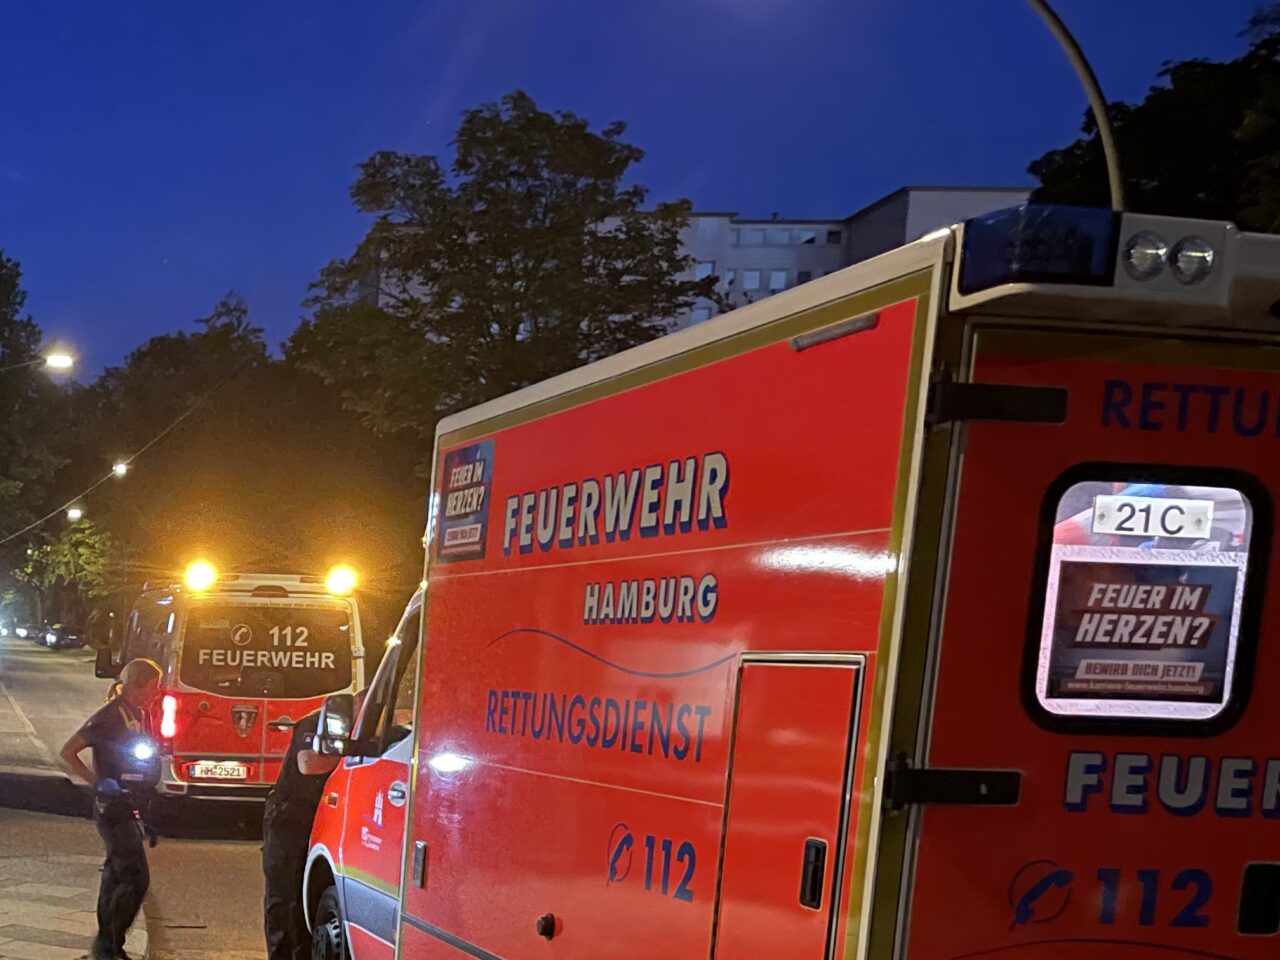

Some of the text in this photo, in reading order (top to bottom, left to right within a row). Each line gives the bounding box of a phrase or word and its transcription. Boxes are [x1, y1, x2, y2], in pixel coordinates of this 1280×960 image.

[1100, 379, 1280, 438] RETTU
[450, 463, 474, 489] FEUER
[502, 451, 730, 556] FEUERWEHR
[583, 573, 719, 625] HAMBURG
[1086, 582, 1203, 611] FEUER IM
[268, 626, 309, 647] 112
[1075, 612, 1211, 646] HERZEN?
[198, 649, 335, 669] FEUERWEHR
[1131, 663, 1158, 677] DICH
[1159, 664, 1197, 679] JETZT!
[486, 689, 712, 762] RETTUNGSDIENST
[218, 767, 241, 777] 2521
[644, 835, 697, 902] 112
[1096, 866, 1214, 929] 112
